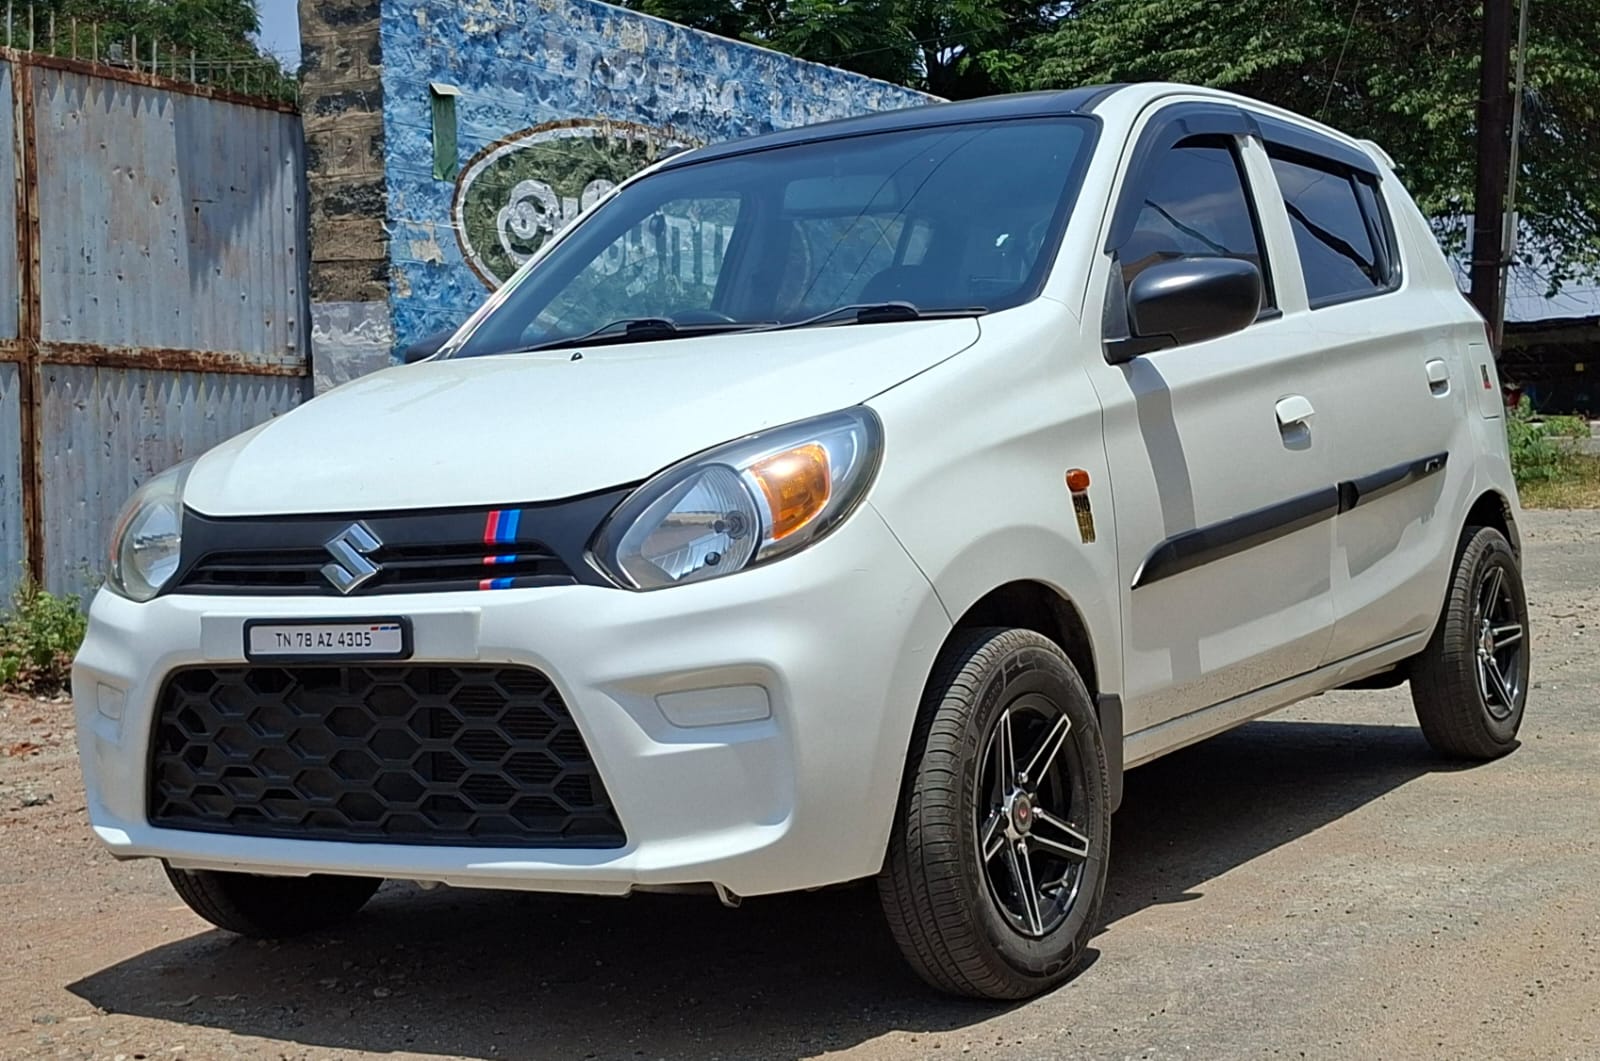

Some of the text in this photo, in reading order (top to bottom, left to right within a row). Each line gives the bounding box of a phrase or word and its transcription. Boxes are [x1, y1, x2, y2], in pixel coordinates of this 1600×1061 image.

[275, 632, 372, 648] TN 78 AZ 4305
